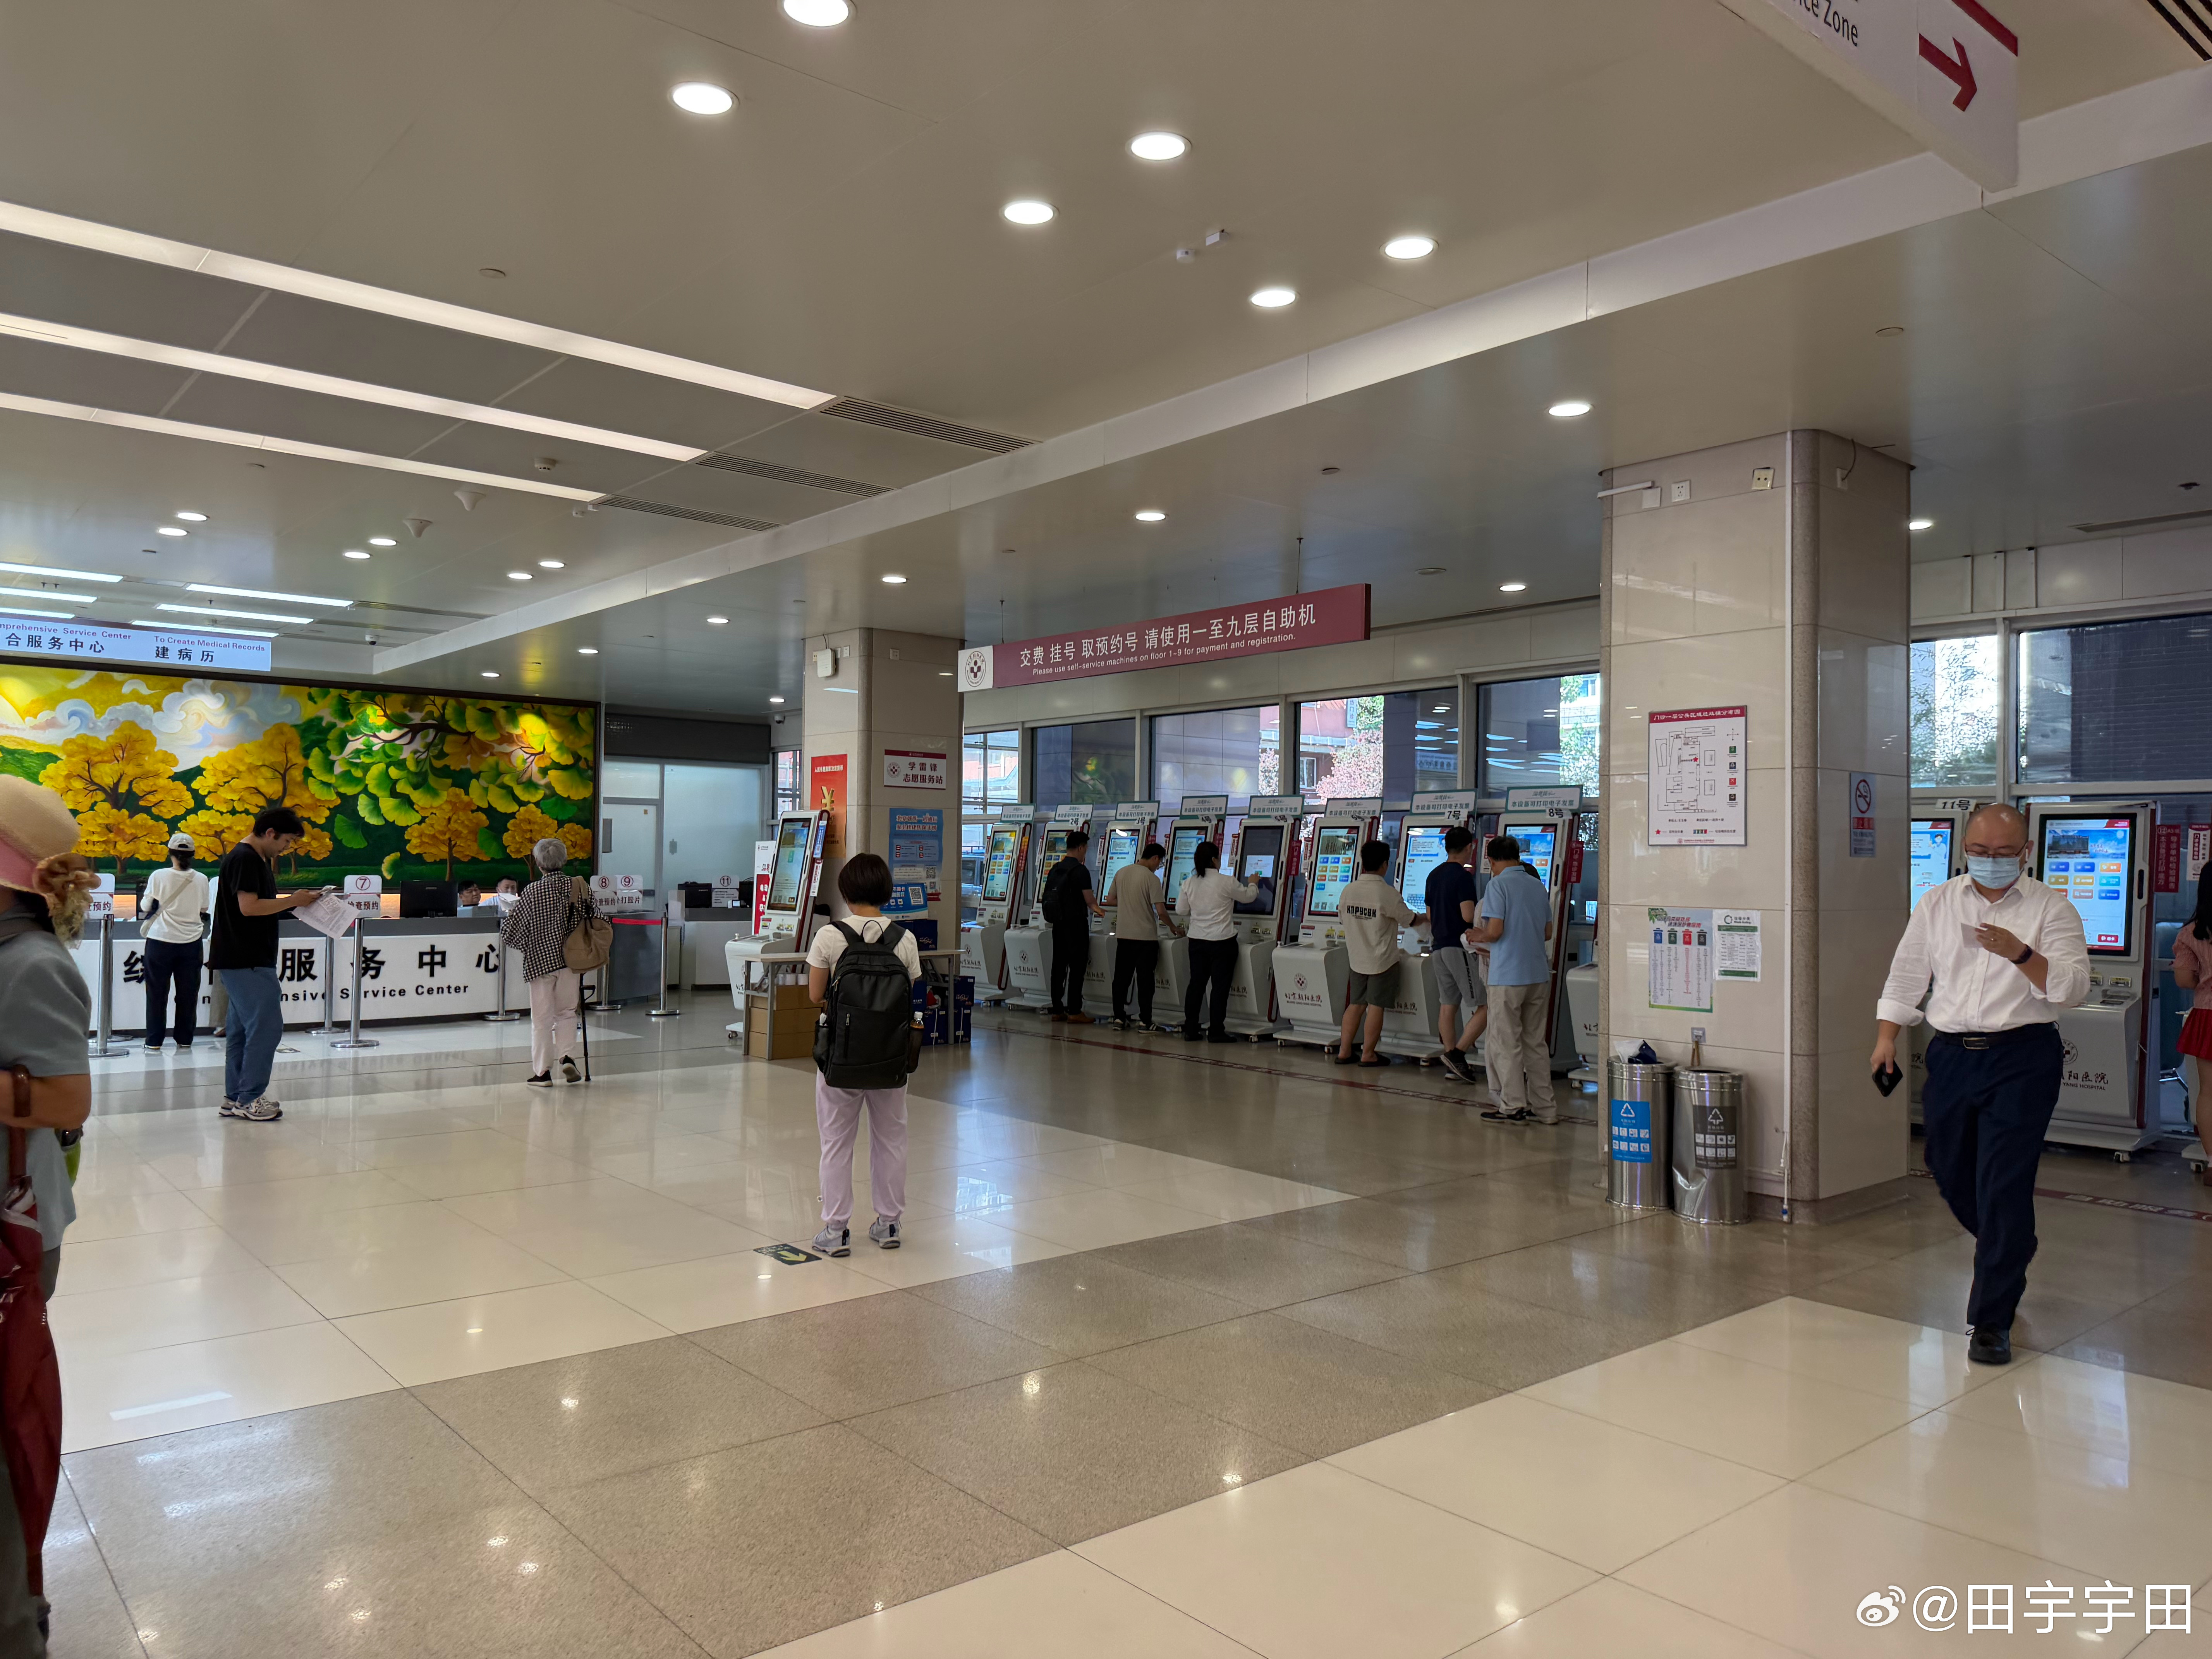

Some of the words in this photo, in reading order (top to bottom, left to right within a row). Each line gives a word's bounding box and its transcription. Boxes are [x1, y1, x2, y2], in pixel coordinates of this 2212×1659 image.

[1824, 0, 1858, 46] Zone
[63, 627, 97, 637] Service
[102, 631, 131, 640] Center
[1020, 646, 1044, 667] 交费
[1050, 641, 1075, 663] 挂号
[1082, 632, 1138, 659] 取预约号
[1145, 603, 1316, 650] 请使用一至九层自助机
[5, 632, 105, 653] 合服务中心
[167, 637, 195, 645] Create
[198, 639, 230, 648] Medical
[232, 643, 265, 651] Records
[155, 646, 214, 663] 建病历
[1033, 668, 1053, 676] Please
[1067, 661, 1104, 671] self-service
[1107, 656, 1138, 666] machines
[1151, 651, 1166, 660] floor
[1197, 642, 1228, 656] payment
[1230, 639, 1245, 648] and
[1247, 633, 1296, 647] registration.
[1942, 799, 1970, 811] 11号
[1447, 811, 1461, 820] 7号
[1549, 808, 1564, 818] 8号
[124, 944, 500, 984] 服务中心
[340, 986, 406, 999] Srvice
[415, 985, 469, 996] Center
